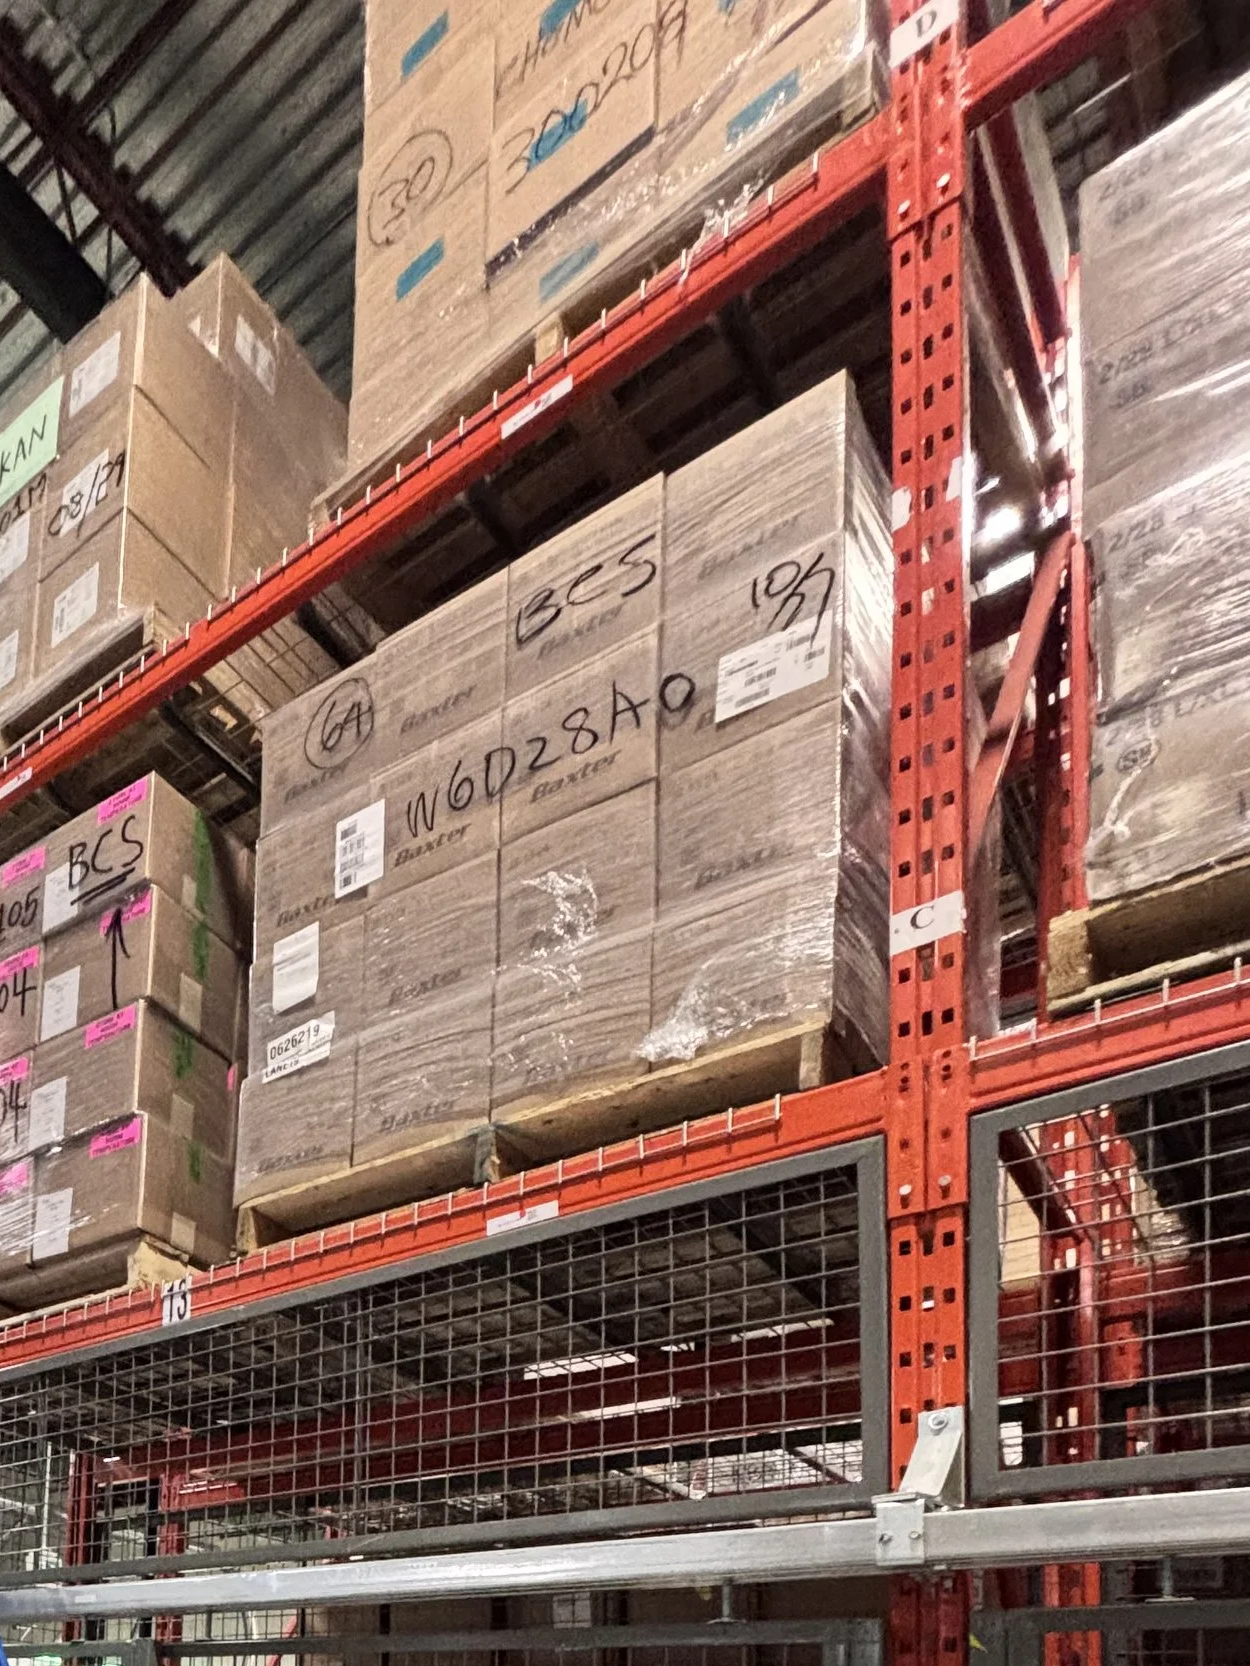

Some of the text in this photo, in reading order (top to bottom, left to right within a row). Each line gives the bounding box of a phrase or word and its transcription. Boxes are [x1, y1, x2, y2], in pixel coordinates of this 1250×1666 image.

[915, 10, 937, 38] D
[516, 533, 656, 648] BCS
[531, 749, 622, 803] Baxter
[68, 814, 144, 891] BCS
[395, 823, 472, 868] Baxter
[910, 903, 936, 929] C
[166, 1278, 188, 1323] 13
